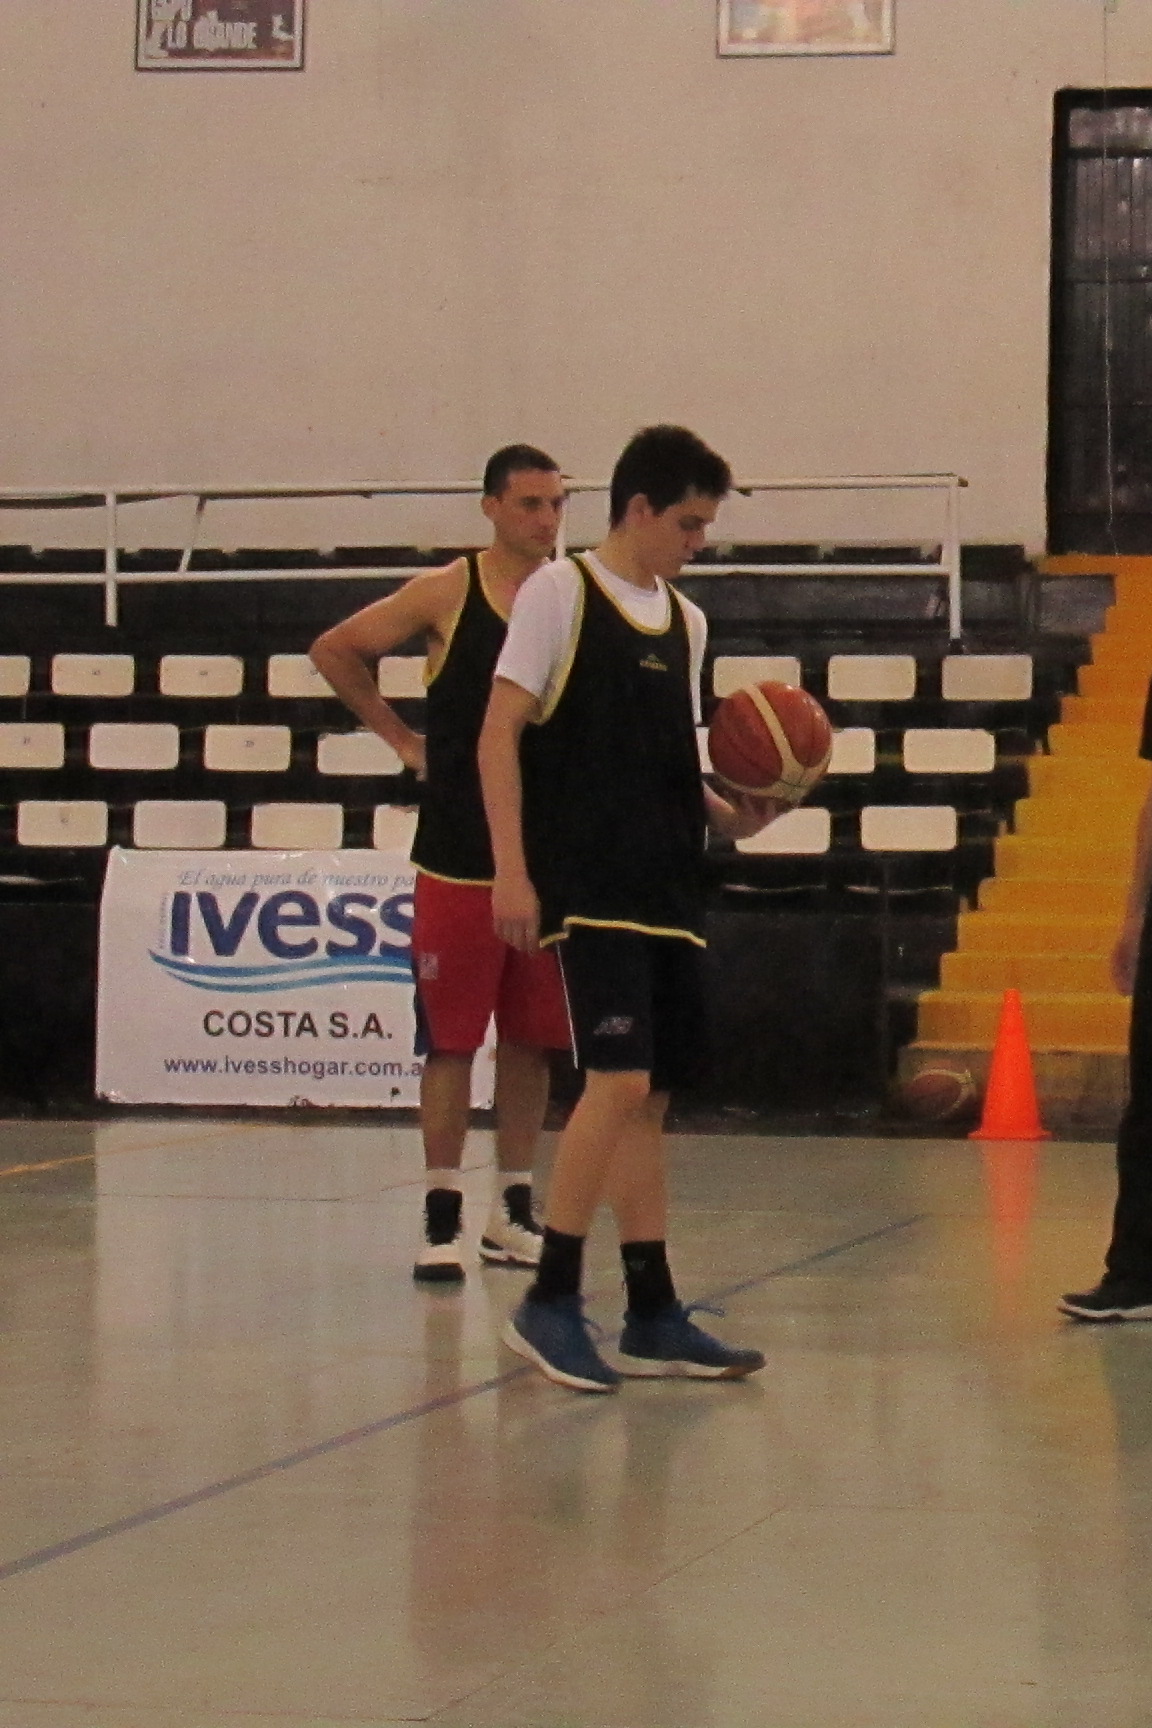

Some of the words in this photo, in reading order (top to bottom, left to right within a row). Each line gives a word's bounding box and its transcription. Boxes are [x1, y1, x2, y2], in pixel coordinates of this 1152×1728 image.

[205, 874, 247, 889] agua
[250, 874, 292, 891] pura
[297, 868, 317, 885] de
[322, 874, 389, 887] nuestro
[203, 1010, 319, 1039] COSTA
[329, 1010, 393, 1039] S.A.
